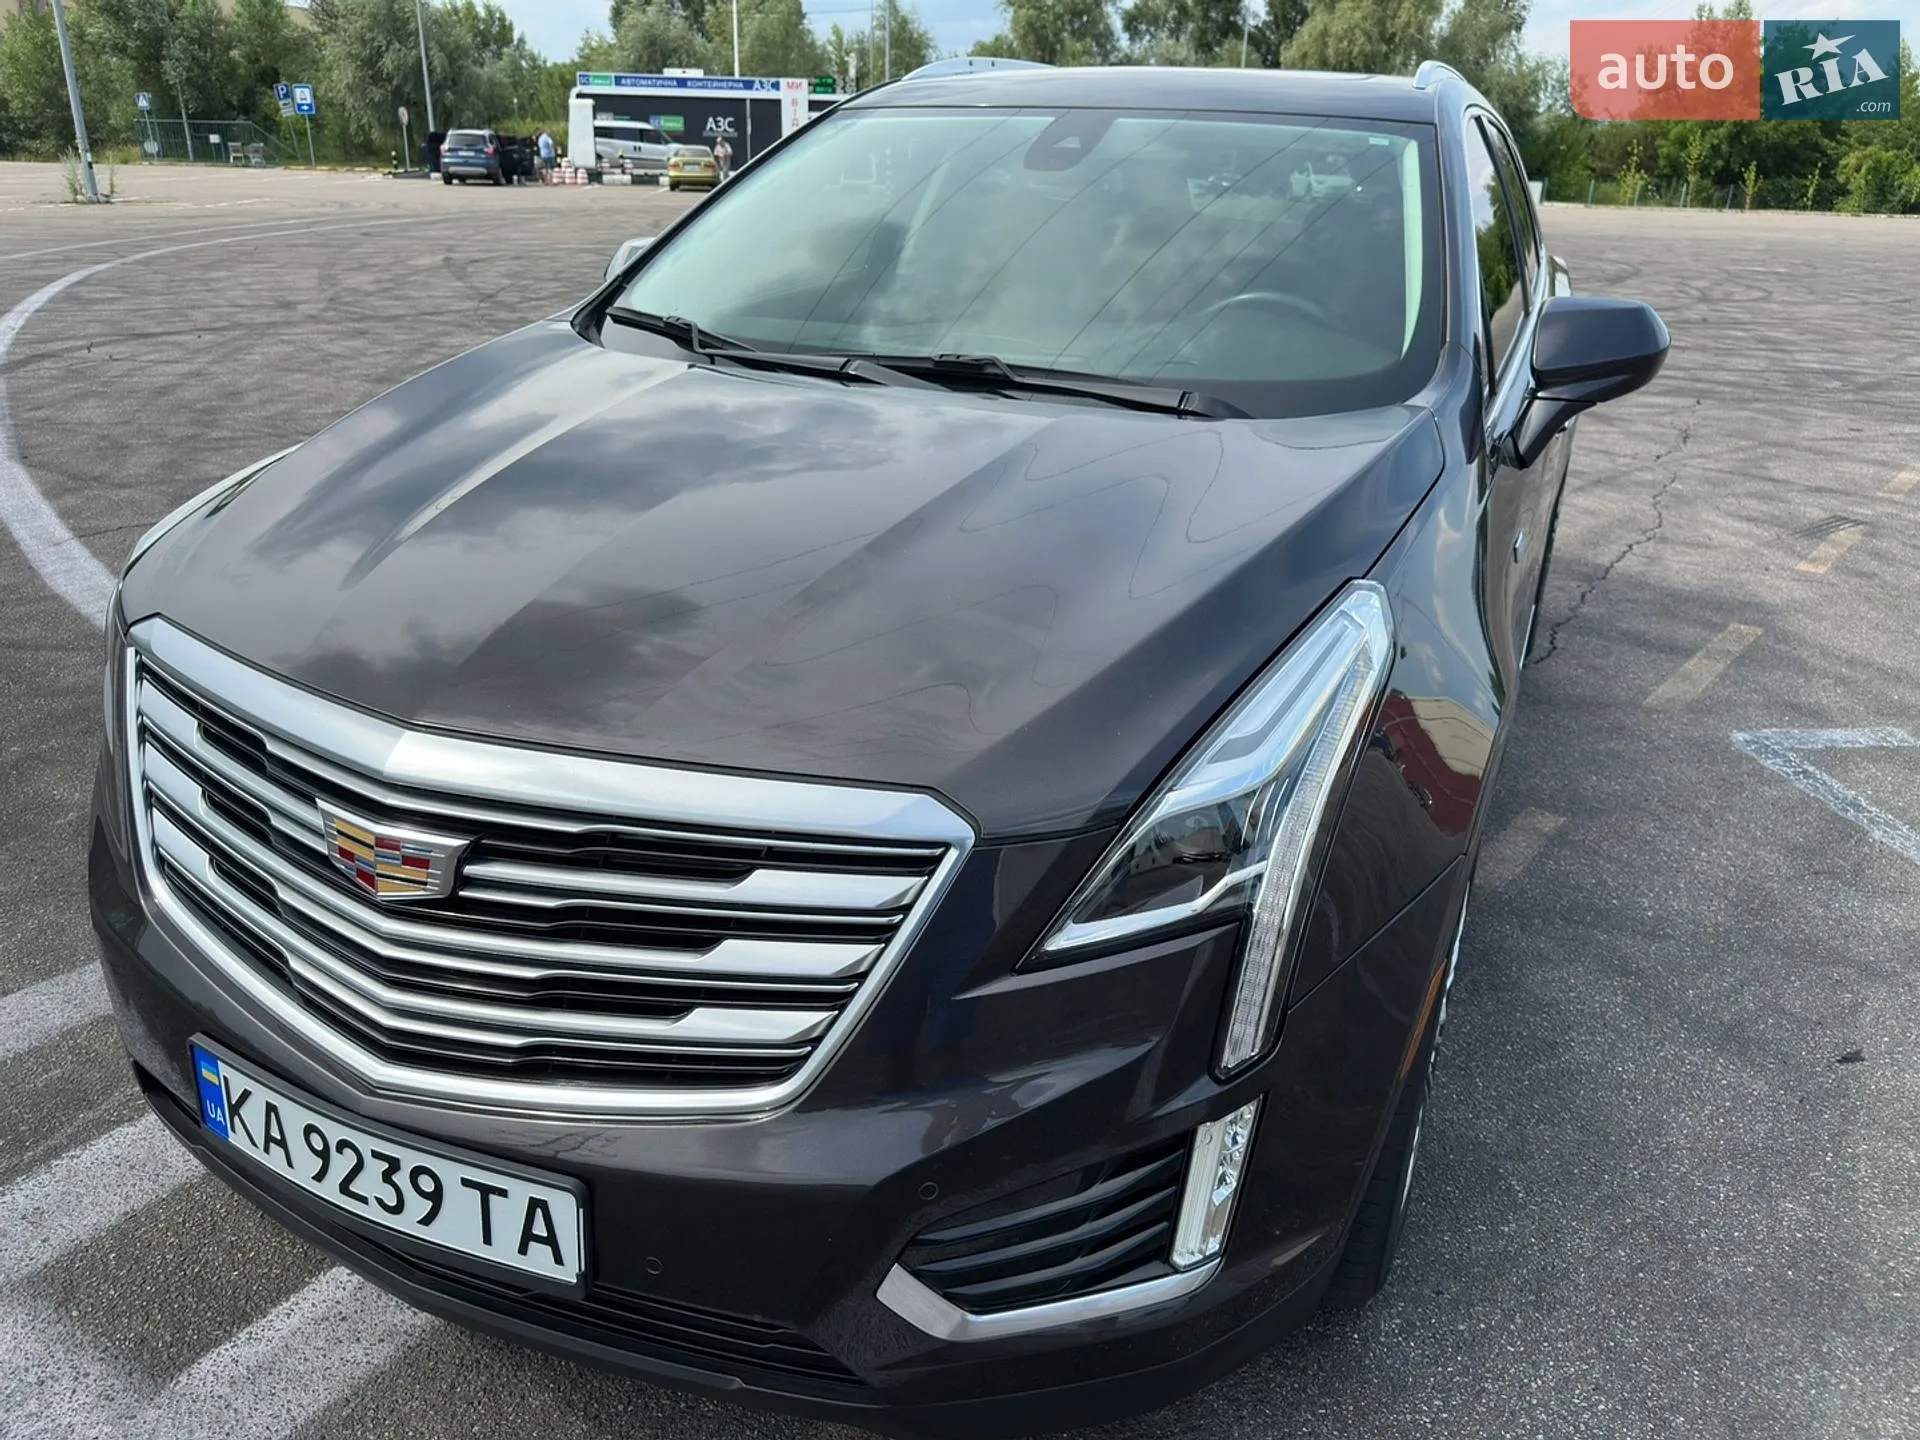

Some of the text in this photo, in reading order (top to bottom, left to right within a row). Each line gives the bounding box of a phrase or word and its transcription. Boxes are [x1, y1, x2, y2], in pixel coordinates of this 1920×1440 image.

[620, 77, 678, 88] АВТОМАТИЧНА
[686, 80, 744, 90] КОНТЕЙНЕРНА
[752, 80, 777, 92] АЗС
[705, 116, 735, 132] АЗС
[206, 1103, 225, 1127] UA
[222, 1075, 565, 1267] KA 9239 TA
